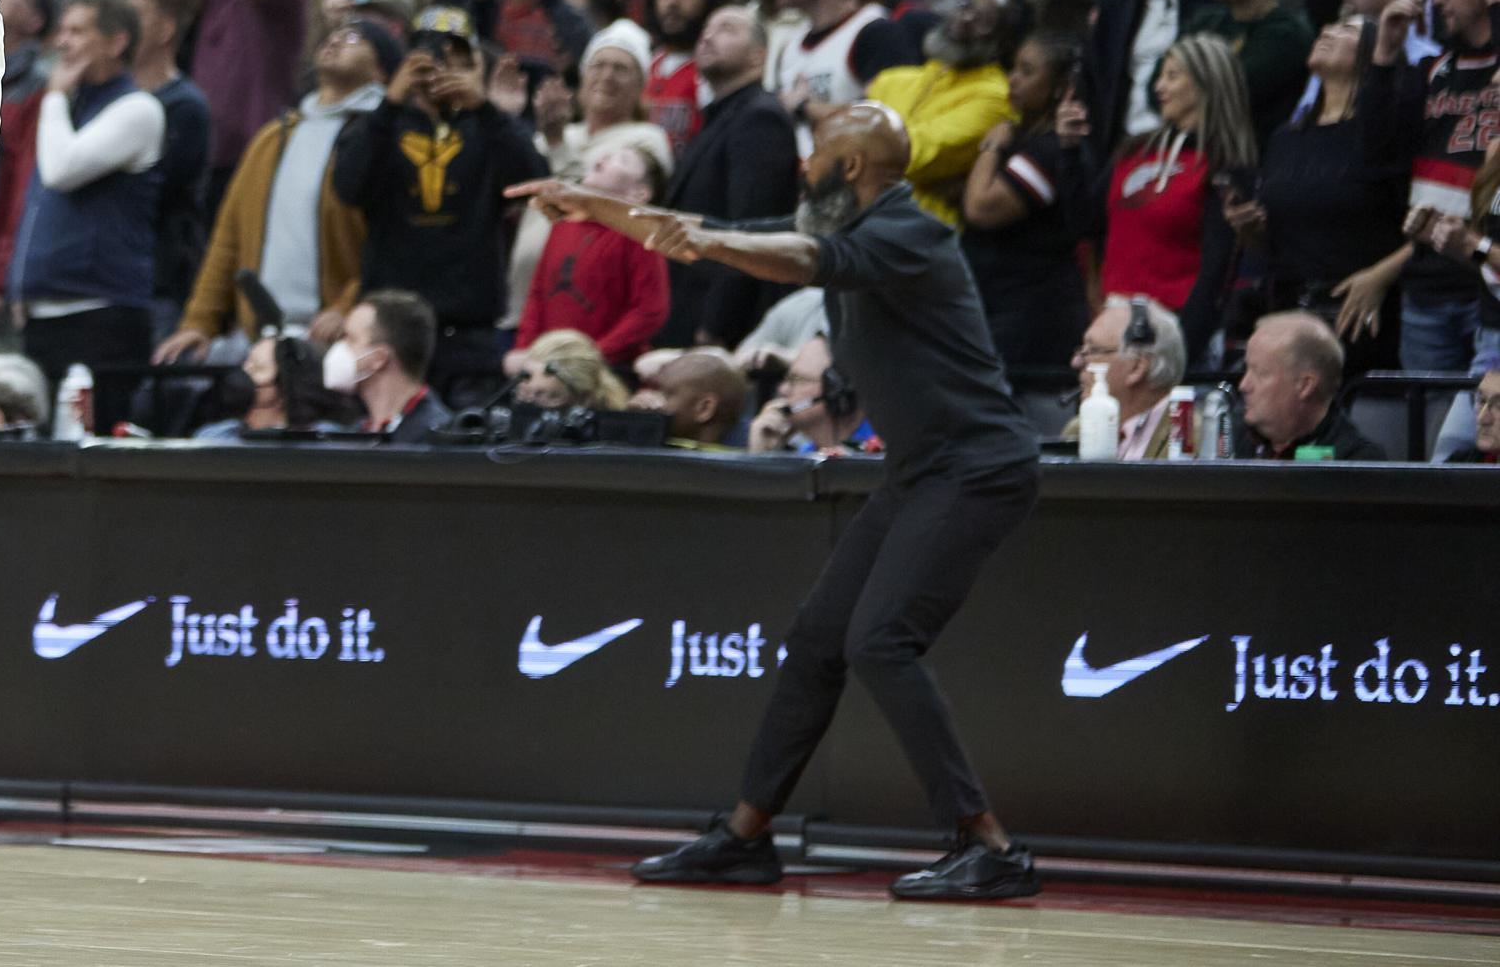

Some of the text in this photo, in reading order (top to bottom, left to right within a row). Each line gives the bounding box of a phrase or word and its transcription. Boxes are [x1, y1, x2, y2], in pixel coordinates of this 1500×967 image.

[164, 595, 385, 667] Just do it.
[665, 620, 766, 687] Just
[1226, 636, 1500, 712] Just do it.
